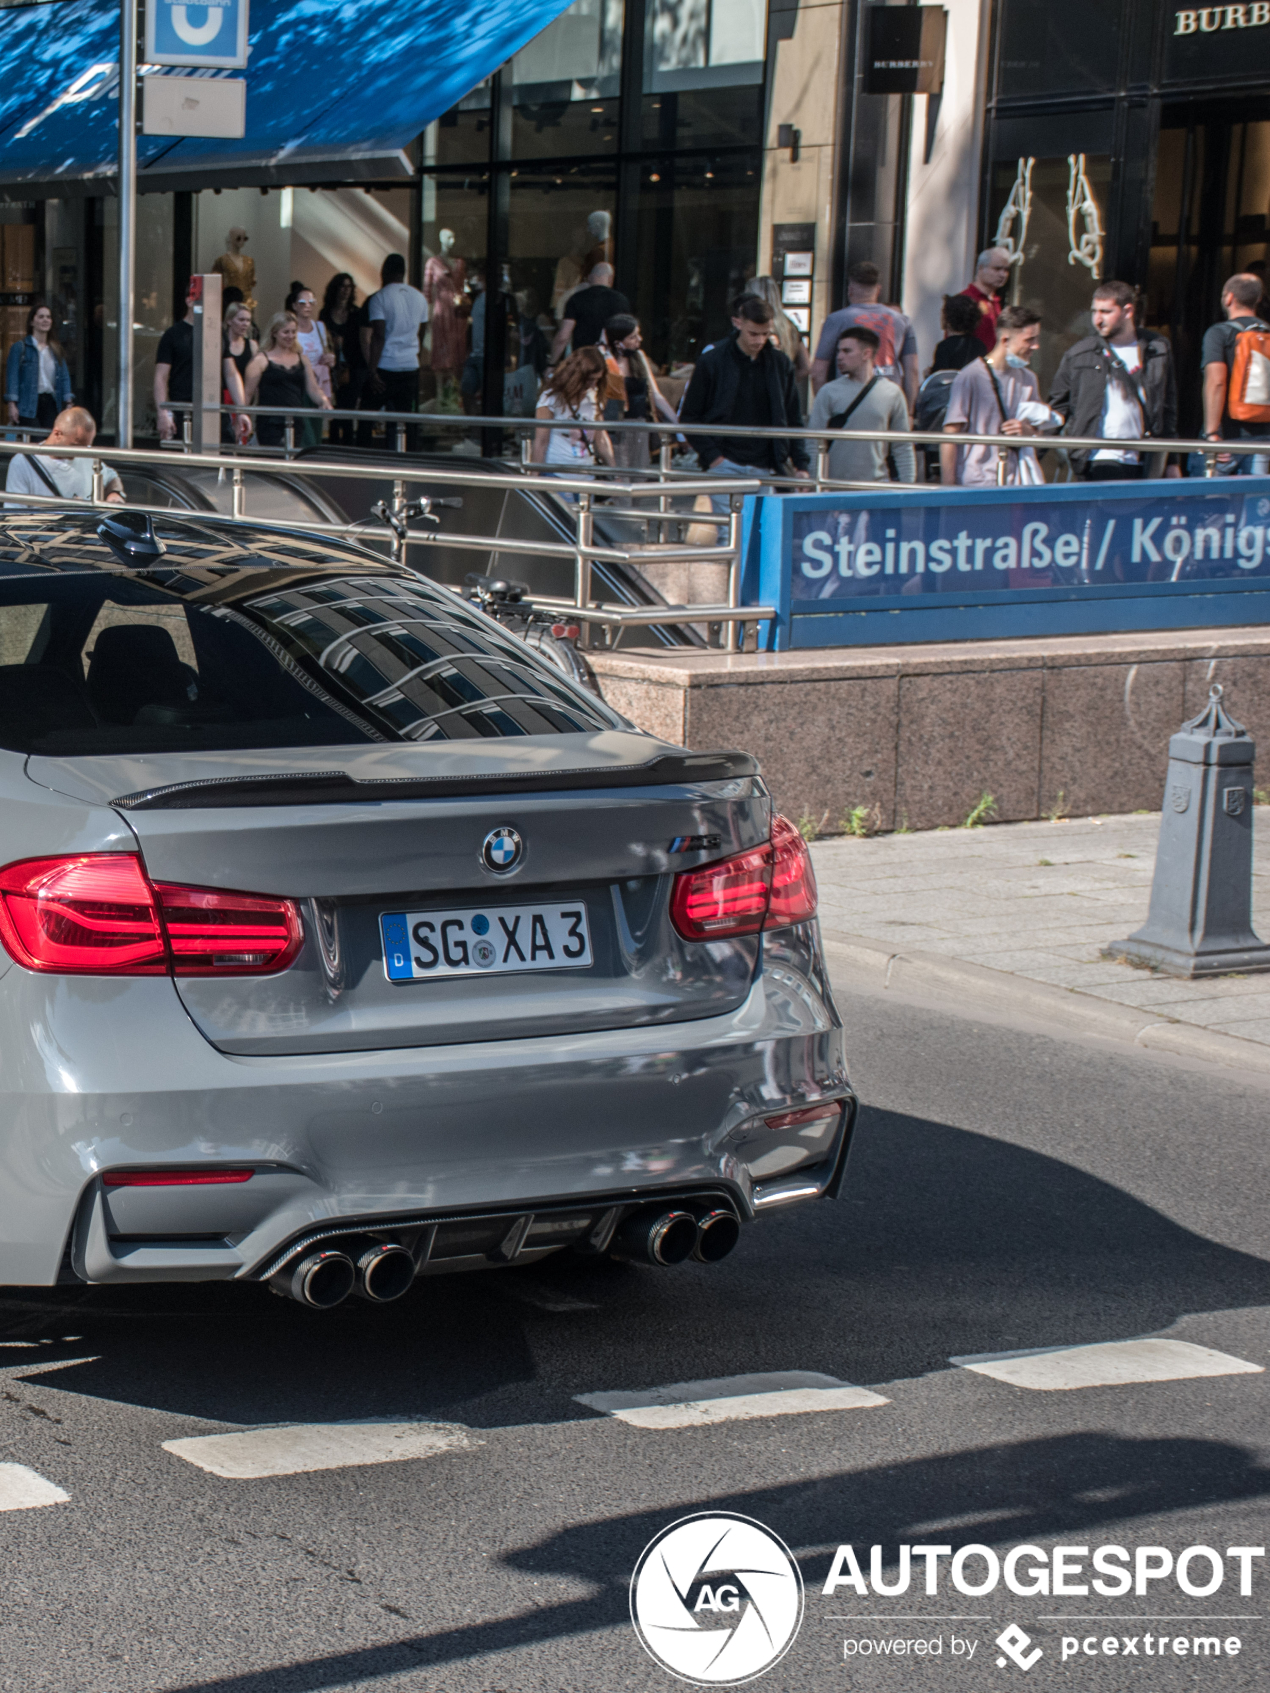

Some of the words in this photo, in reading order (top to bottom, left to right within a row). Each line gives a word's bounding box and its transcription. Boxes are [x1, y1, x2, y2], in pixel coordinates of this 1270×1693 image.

[1130, 513, 1270, 570] König
[394, 953, 404, 967] D
[412, 921, 470, 969] SG
